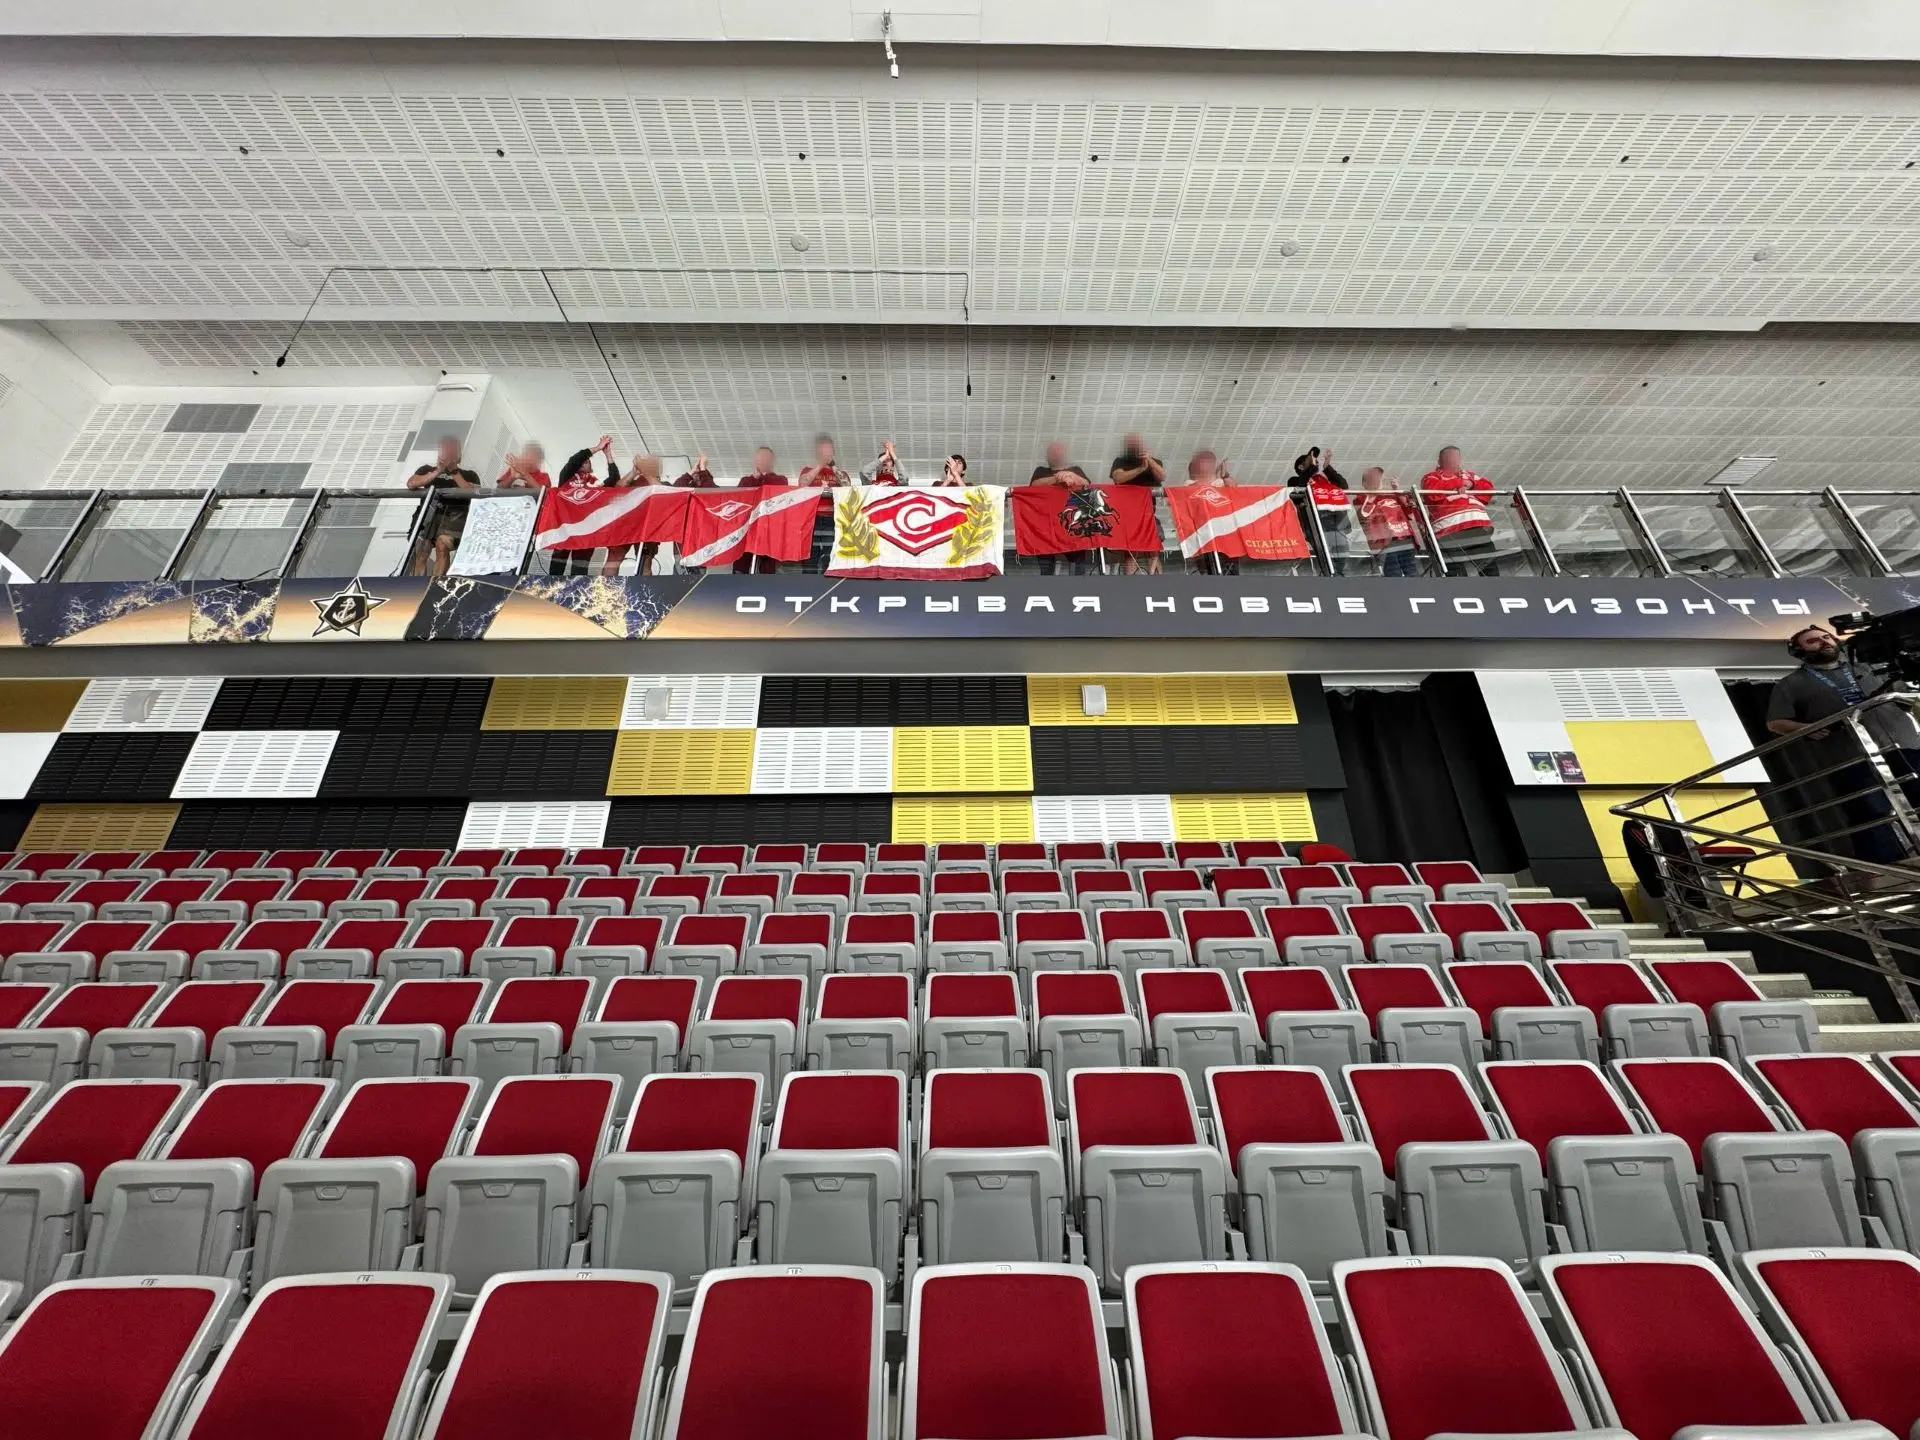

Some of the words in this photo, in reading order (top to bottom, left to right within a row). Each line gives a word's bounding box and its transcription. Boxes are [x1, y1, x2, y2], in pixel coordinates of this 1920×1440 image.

[735, 596, 1101, 613] ОТКРЫВАЯ
[1145, 596, 1368, 613] НОВЫЕ
[1409, 597, 1811, 615] ГОРИЗОНТЫ
